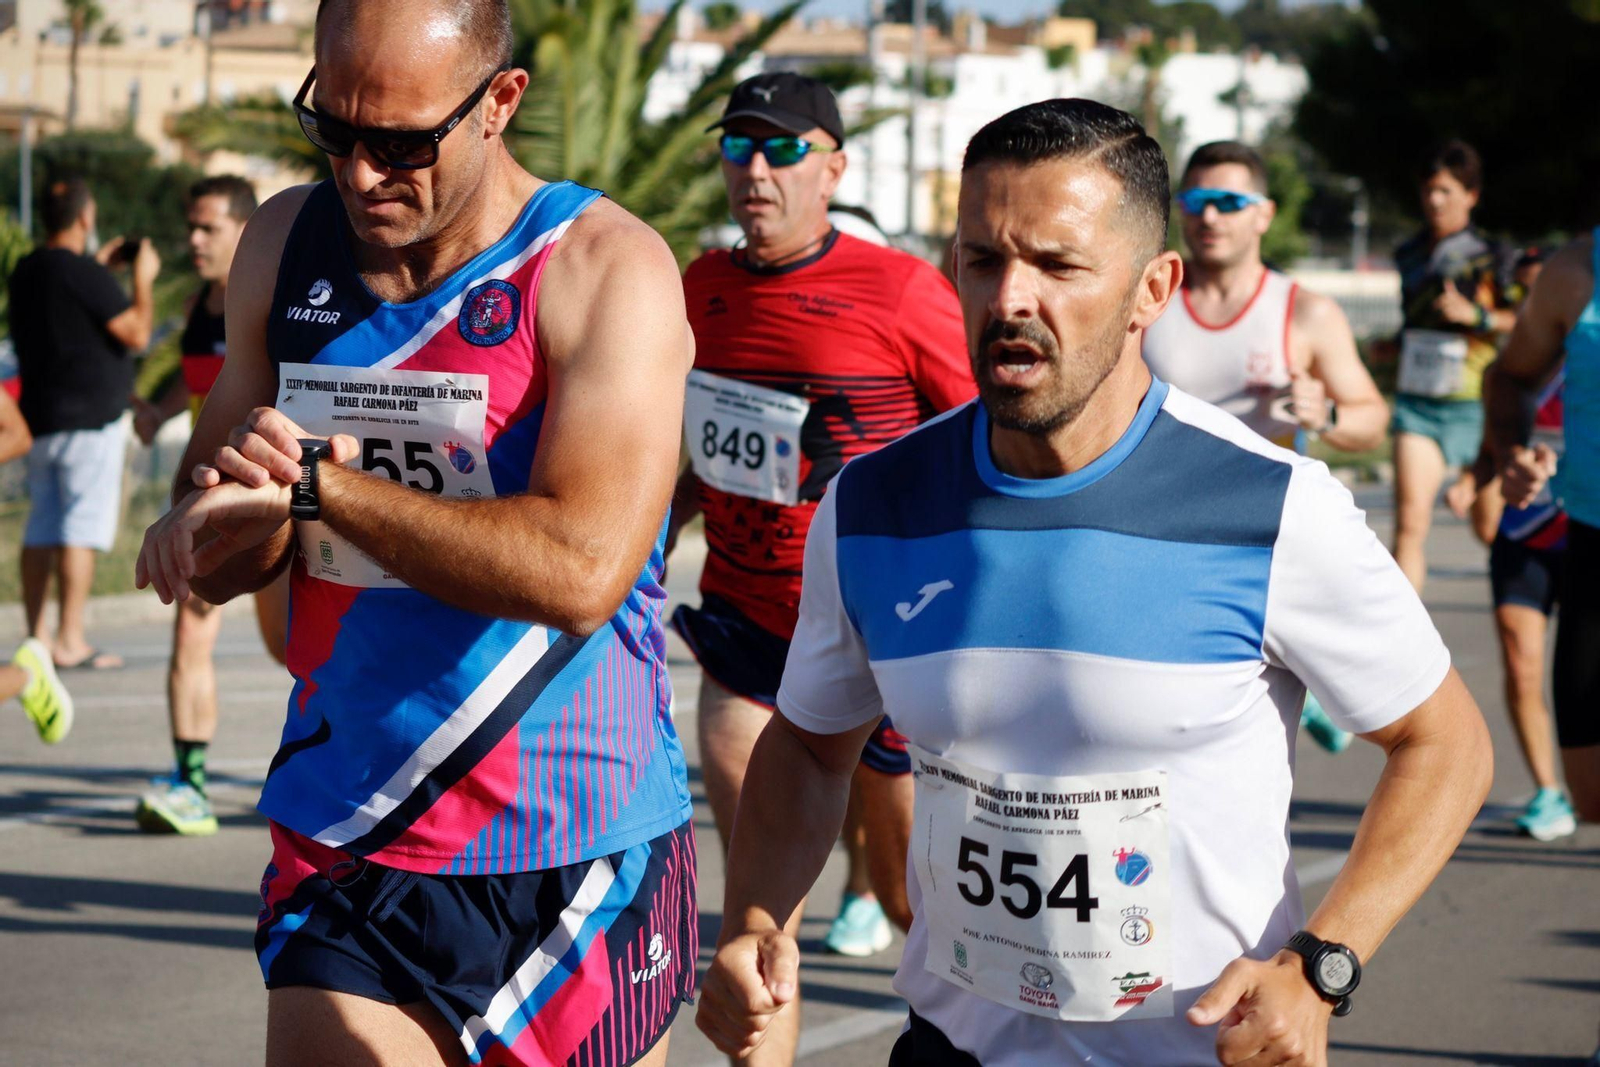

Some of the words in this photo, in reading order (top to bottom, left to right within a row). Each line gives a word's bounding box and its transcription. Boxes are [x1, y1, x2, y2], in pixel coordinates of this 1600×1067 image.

[286, 306, 341, 325] VIATOR
[286, 378, 304, 390] XXXIV
[304, 380, 338, 392] MEMORIAL
[340, 382, 378, 395] SARGENTO
[379, 384, 390, 396] DE
[391, 385, 435, 398] INFANTERÍA
[437, 388, 449, 400] DE
[450, 389, 483, 401] MARINA
[333, 396, 360, 408] RAFAEL
[362, 398, 397, 411] CARMONA
[399, 398, 419, 412] PÁEZ
[702, 420, 766, 471] 849
[940, 767, 979, 791] MEMORIAL
[980, 782, 1023, 803] SARGENTO
[1026, 791, 1040, 804] DE
[1042, 790, 1101, 805] INFANTERÍA
[1104, 789, 1119, 801] DE
[1121, 786, 1160, 800] MARINA
[974, 795, 1001, 815] RAFAEL
[1003, 805, 1051, 820] CARMONA
[1053, 806, 1080, 820] PÁEZ
[956, 836, 1099, 923] 554
[962, 926, 981, 940] JOSE
[983, 933, 1023, 950] ANTONIO
[1023, 944, 1060, 959] MEDINA
[1062, 950, 1112, 959] RAMIREZ
[631, 949, 672, 985] VIATOR
[1018, 984, 1057, 1001] TOYOTA
